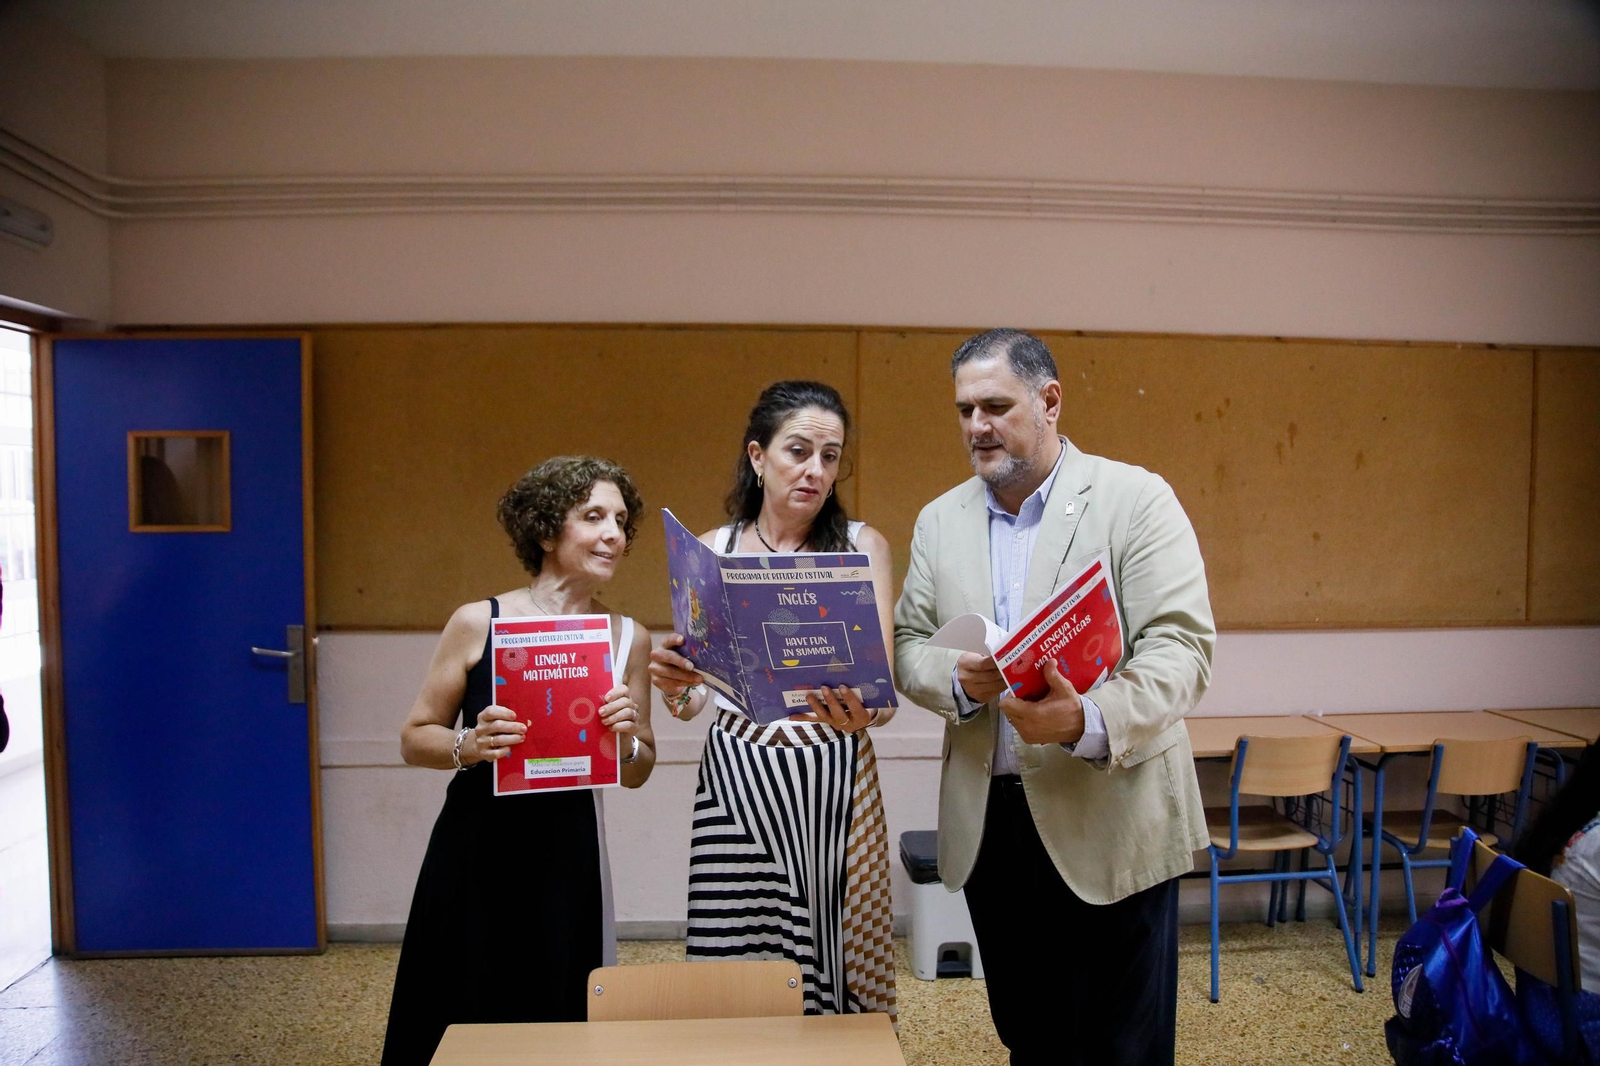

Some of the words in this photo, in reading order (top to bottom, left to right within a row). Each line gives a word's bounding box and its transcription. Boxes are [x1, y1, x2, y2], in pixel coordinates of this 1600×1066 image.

[726, 572, 761, 580] PROGRAMA
[762, 572, 770, 580] DE
[771, 571, 804, 580] REFUERZO
[804, 570, 834, 579] ESTIVAL
[777, 589, 818, 606] INGLÉS
[1039, 621, 1071, 652] LENGUA
[1070, 613, 1077, 624] Y
[785, 637, 808, 646] HAVE
[809, 636, 828, 645] FUN
[1034, 614, 1092, 671] MATEMÁTICAS
[782, 648, 794, 657] IN
[795, 645, 836, 657] SUMMER!
[534, 653, 568, 666] LENGUA
[569, 652, 577, 664] Y
[523, 665, 589, 681] MATEMÁTICAS
